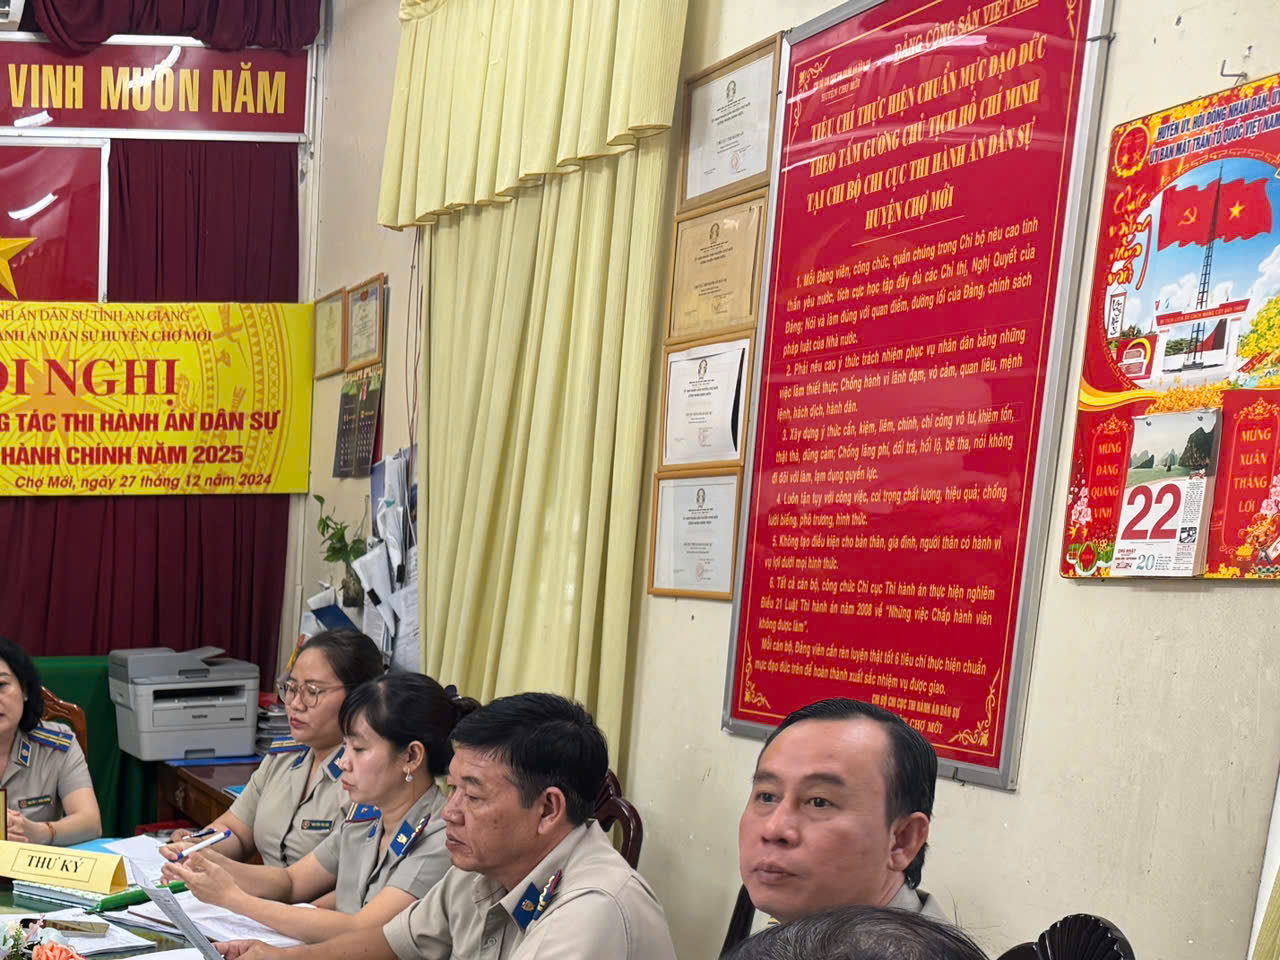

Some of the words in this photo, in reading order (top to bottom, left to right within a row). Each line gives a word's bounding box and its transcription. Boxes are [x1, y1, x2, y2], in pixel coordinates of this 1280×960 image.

[8, 63, 84, 109] VINH
[211, 62, 286, 114] NĂM
[809, 115, 834, 146] TIÊU
[836, 104, 855, 134] CHÍ
[855, 96, 886, 133] THỰC
[887, 84, 915, 116] HIỆN
[917, 61, 956, 104] CHUẨN
[958, 56, 987, 90] MỰC
[988, 48, 1016, 79] ĐẠO
[1017, 31, 1048, 67] ĐỨC
[809, 152, 836, 177] THEO
[839, 131, 863, 168] TẤM
[901, 112, 926, 146] CHỦ
[928, 109, 957, 141] TỊCH
[957, 90, 977, 129] HỒ
[979, 86, 1003, 120] CHÍ
[1004, 79, 1040, 111] MINH
[807, 189, 825, 215] TẠI
[826, 183, 845, 206] CHI
[846, 173, 862, 203] BỘ
[864, 171, 883, 195] CHI
[885, 163, 907, 191] CỤC
[910, 156, 930, 181] THI
[931, 138, 967, 174] HÀNH
[967, 134, 986, 163] ÁN
[987, 125, 1015, 157] DÂN
[1016, 116, 1036, 151] SỰ
[865, 198, 903, 230] HUYỆN
[904, 190, 929, 220] CHỢ
[929, 182, 954, 212] MỚI
[15, 307, 37, 321] ÁN
[39, 307, 69, 321] DÂN
[70, 308, 89, 323] SỰ
[92, 306, 123, 321] TỈNH
[125, 309, 145, 321] AN
[147, 309, 190, 321] GIANG
[27, 327, 47, 342] ÁN
[50, 328, 78, 342] DÂN
[81, 329, 99, 344] SỰ
[101, 327, 149, 344] HUYỆN
[151, 329, 183, 344] CHỢ
[184, 328, 212, 342] MỚI
[44, 358, 179, 407] NGHỊ
[15, 409, 56, 432] TÁC
[62, 413, 94, 432] THI
[100, 409, 159, 432] HÀNH
[164, 409, 194, 432] ÁN
[199, 409, 244, 432] DÂN
[249, 410, 281, 434] SỰ
[1, 442, 60, 465] HÀNH
[66, 443, 132, 465] CHÍNH
[137, 442, 187, 464] NĂM
[192, 445, 244, 464] 2025
[15, 476, 43, 492] Chợ
[48, 475, 76, 489] Mới,
[80, 475, 116, 492] ngày
[120, 476, 136, 488] 27
[140, 474, 180, 491] tháng
[186, 475, 201, 486] 12
[204, 474, 235, 486] năm
[238, 474, 272, 486] 2024
[1121, 483, 1181, 540] 22
[1136, 554, 1155, 570] 20
[27, 854, 61, 872] THƯ
[60, 856, 85, 874] KÝ
